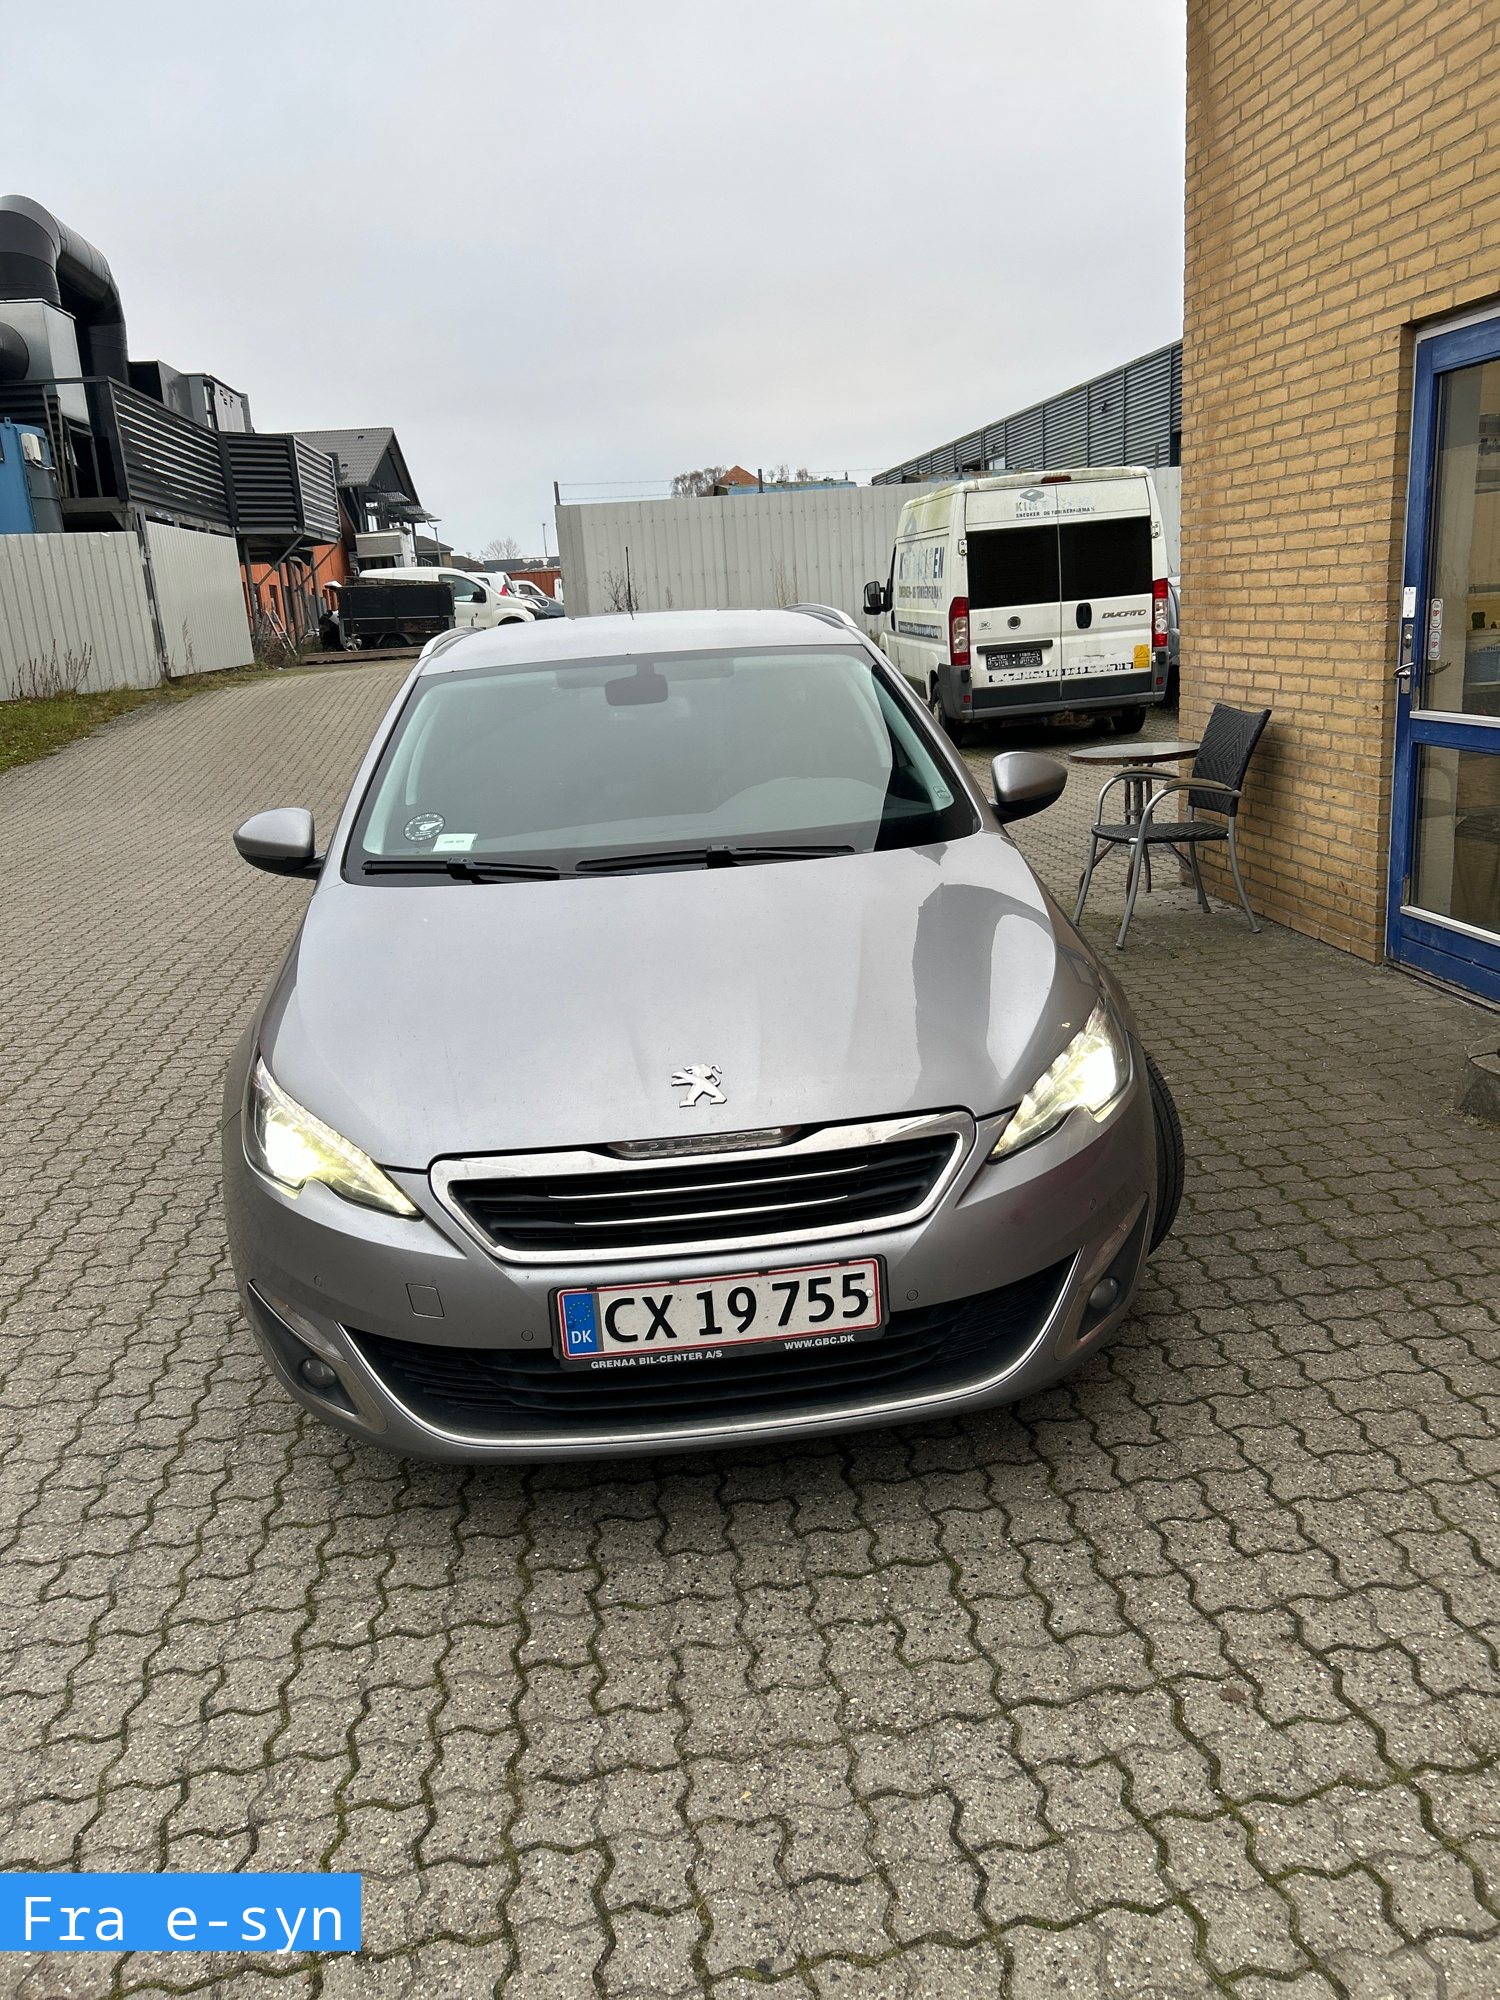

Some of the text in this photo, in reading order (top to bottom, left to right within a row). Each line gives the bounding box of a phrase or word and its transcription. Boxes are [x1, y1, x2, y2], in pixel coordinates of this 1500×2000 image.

[1102, 609, 1147, 619] DUCATO
[648, 1131, 764, 1149] PEUGEOT
[604, 1272, 869, 1343] CX 19 755
[571, 1330, 593, 1345] DK
[784, 1334, 855, 1350] WWW.GBC.DK
[590, 1349, 723, 1370] GRENAA BIL-CENTER A/S
